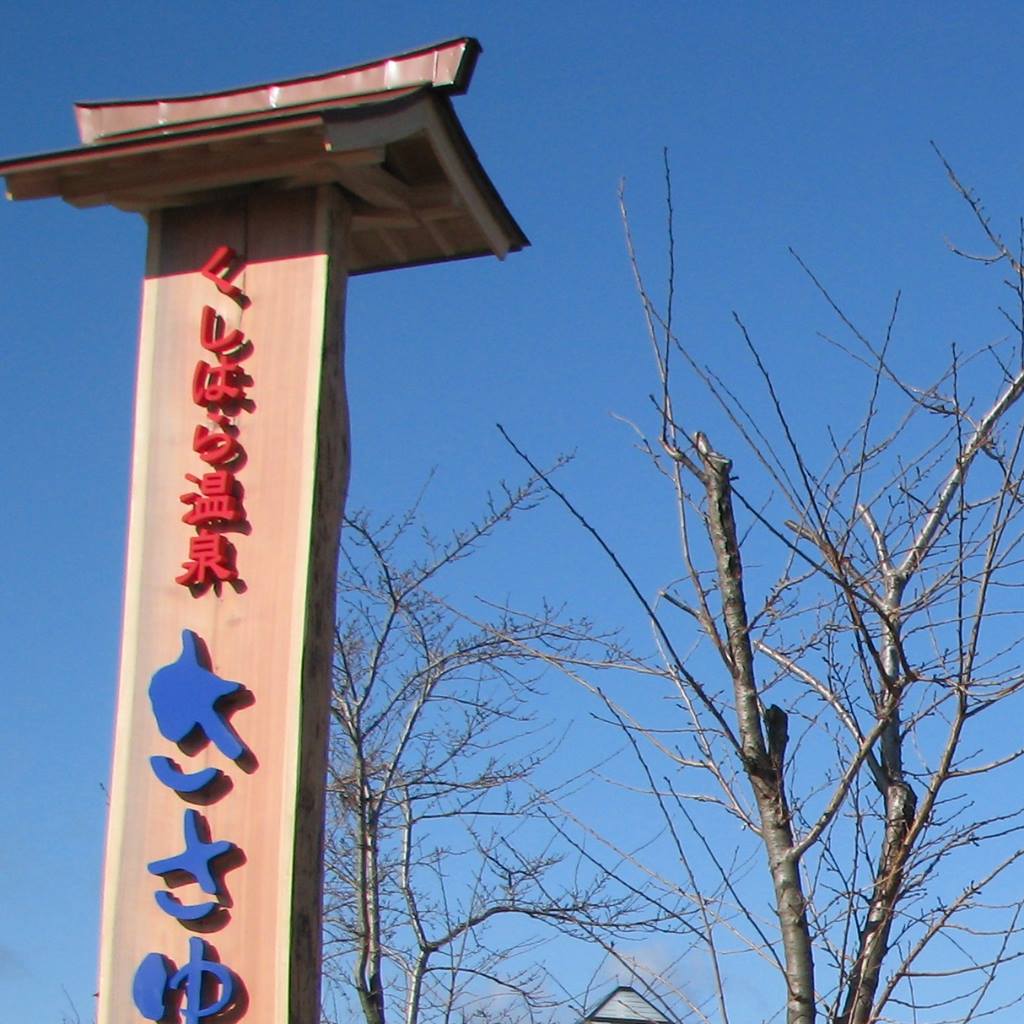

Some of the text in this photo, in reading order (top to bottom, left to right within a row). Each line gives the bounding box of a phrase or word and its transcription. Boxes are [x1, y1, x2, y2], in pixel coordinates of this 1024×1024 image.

[175, 245, 249, 586] くしはら温泉
